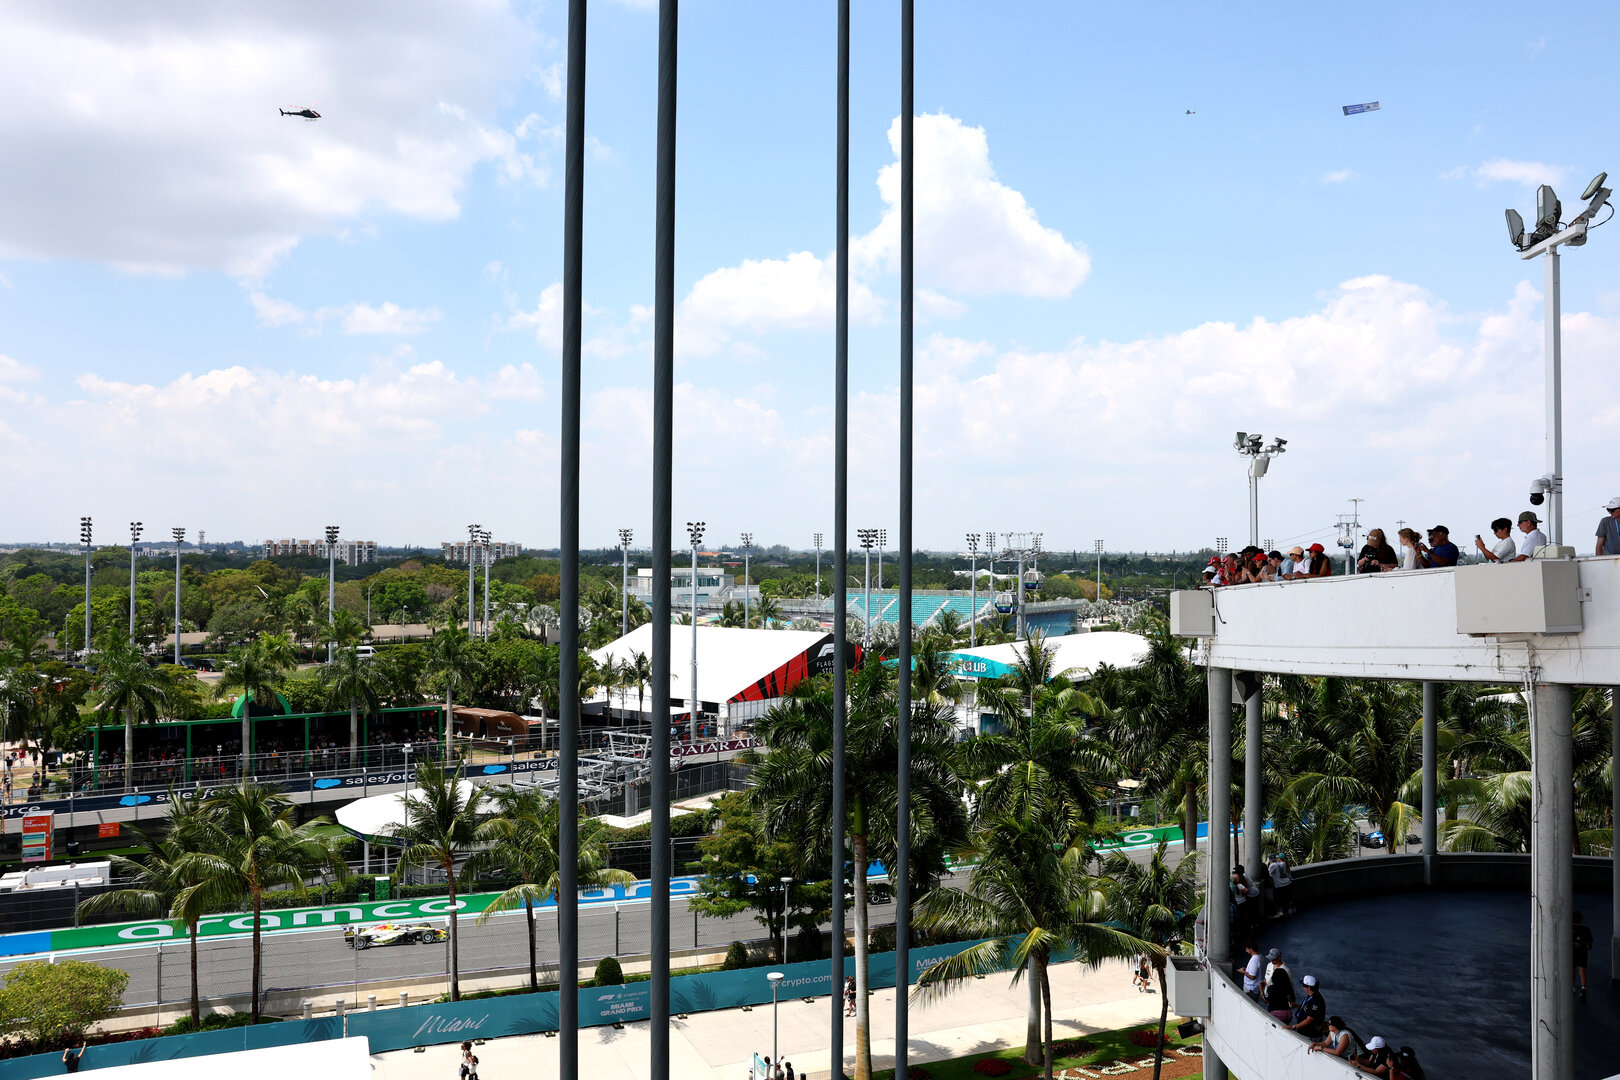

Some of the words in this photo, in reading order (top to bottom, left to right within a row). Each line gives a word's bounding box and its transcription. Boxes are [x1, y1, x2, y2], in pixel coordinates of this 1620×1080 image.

[816, 660, 834, 668] FLAGS
[511, 760, 559, 771] salesfo
[345, 773, 417, 786] saesfoc
[156, 787, 239, 803] slefoc
[117, 900, 467, 939] aramco
[781, 974, 832, 987] crypto.com
[600, 1008, 626, 1016] GRAND
[626, 1005, 643, 1013] PRIX
[610, 1002, 634, 1010] MIAMI
[412, 1013, 489, 1039] Miami
